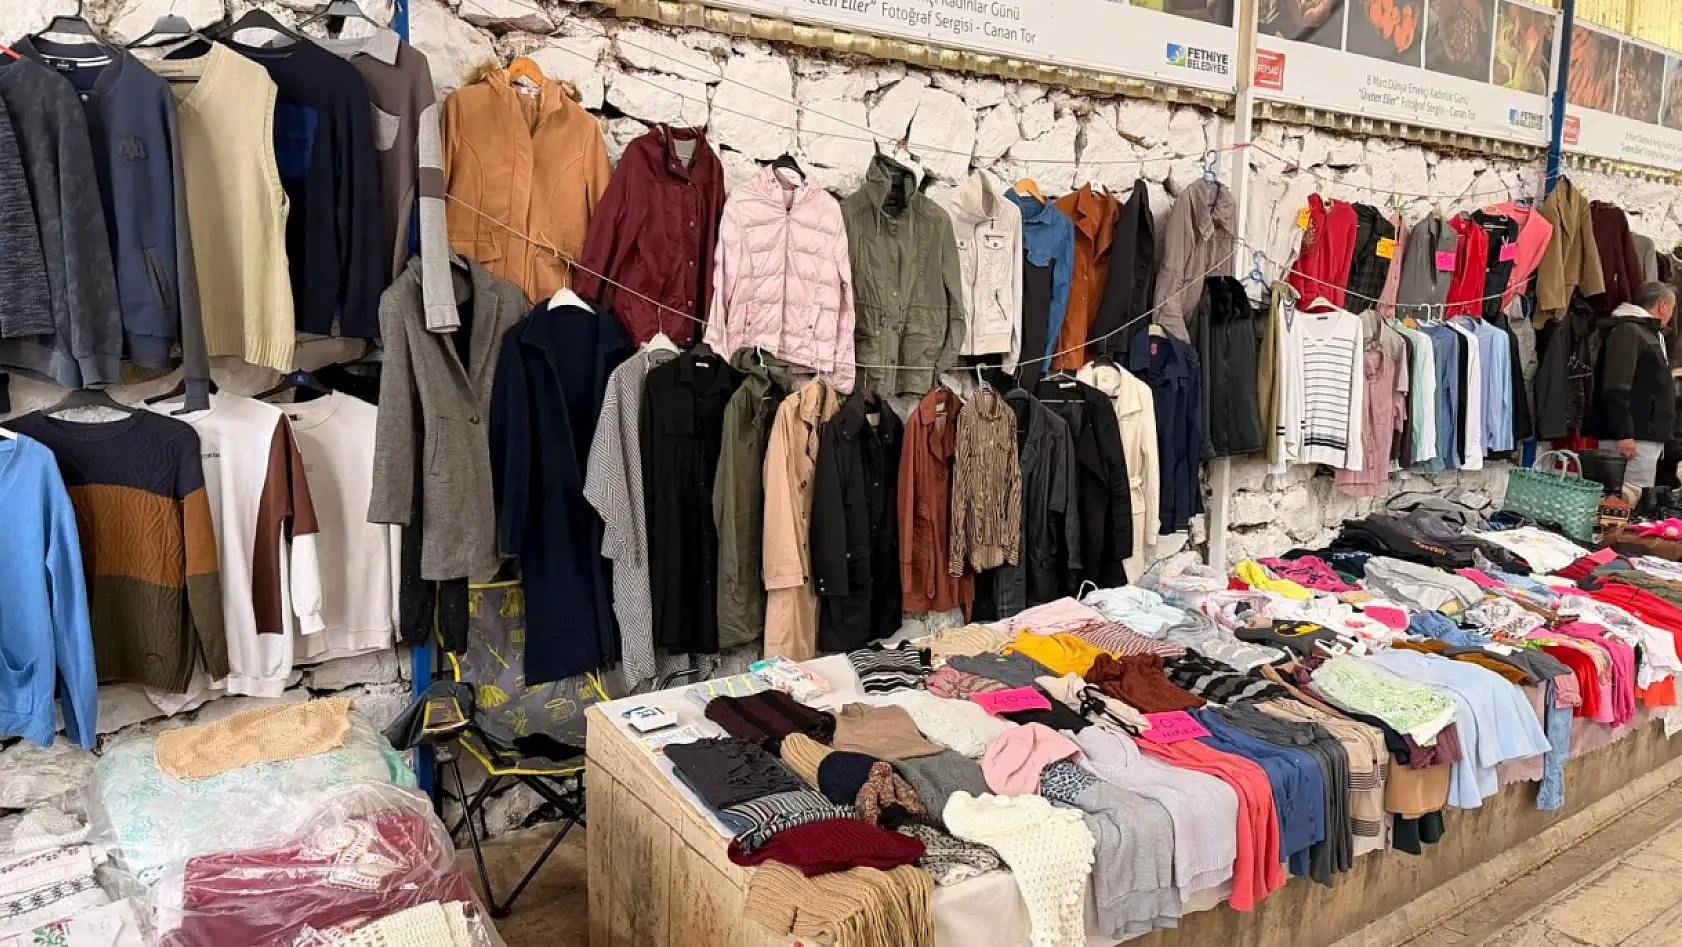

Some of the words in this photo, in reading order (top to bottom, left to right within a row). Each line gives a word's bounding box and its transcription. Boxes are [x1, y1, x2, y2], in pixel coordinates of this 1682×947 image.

[882, 2, 932, 26] Fotoğraf
[935, 11, 973, 34] Sergisi
[984, 21, 1017, 41] Canan
[1020, 28, 1036, 44] Tor
[991, 2, 1020, 20] Günü
